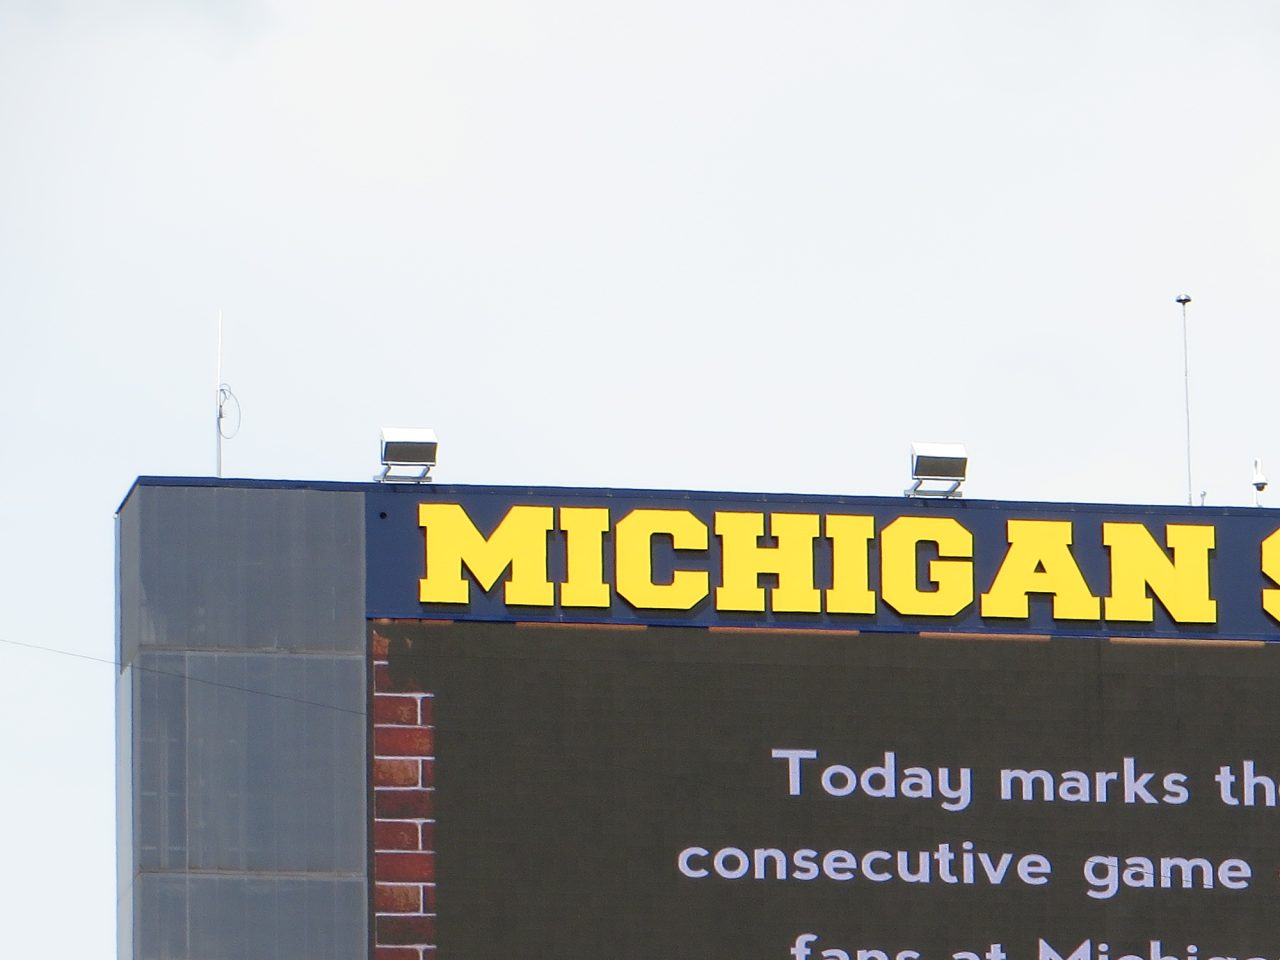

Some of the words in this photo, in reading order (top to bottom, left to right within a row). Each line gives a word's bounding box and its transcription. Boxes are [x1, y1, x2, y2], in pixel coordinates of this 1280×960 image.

[419, 503, 1217, 623] MICHIGAN
[772, 748, 971, 812] Today
[1000, 757, 1189, 805] marks
[677, 841, 1052, 885] consecutive
[1083, 855, 1252, 899] game
